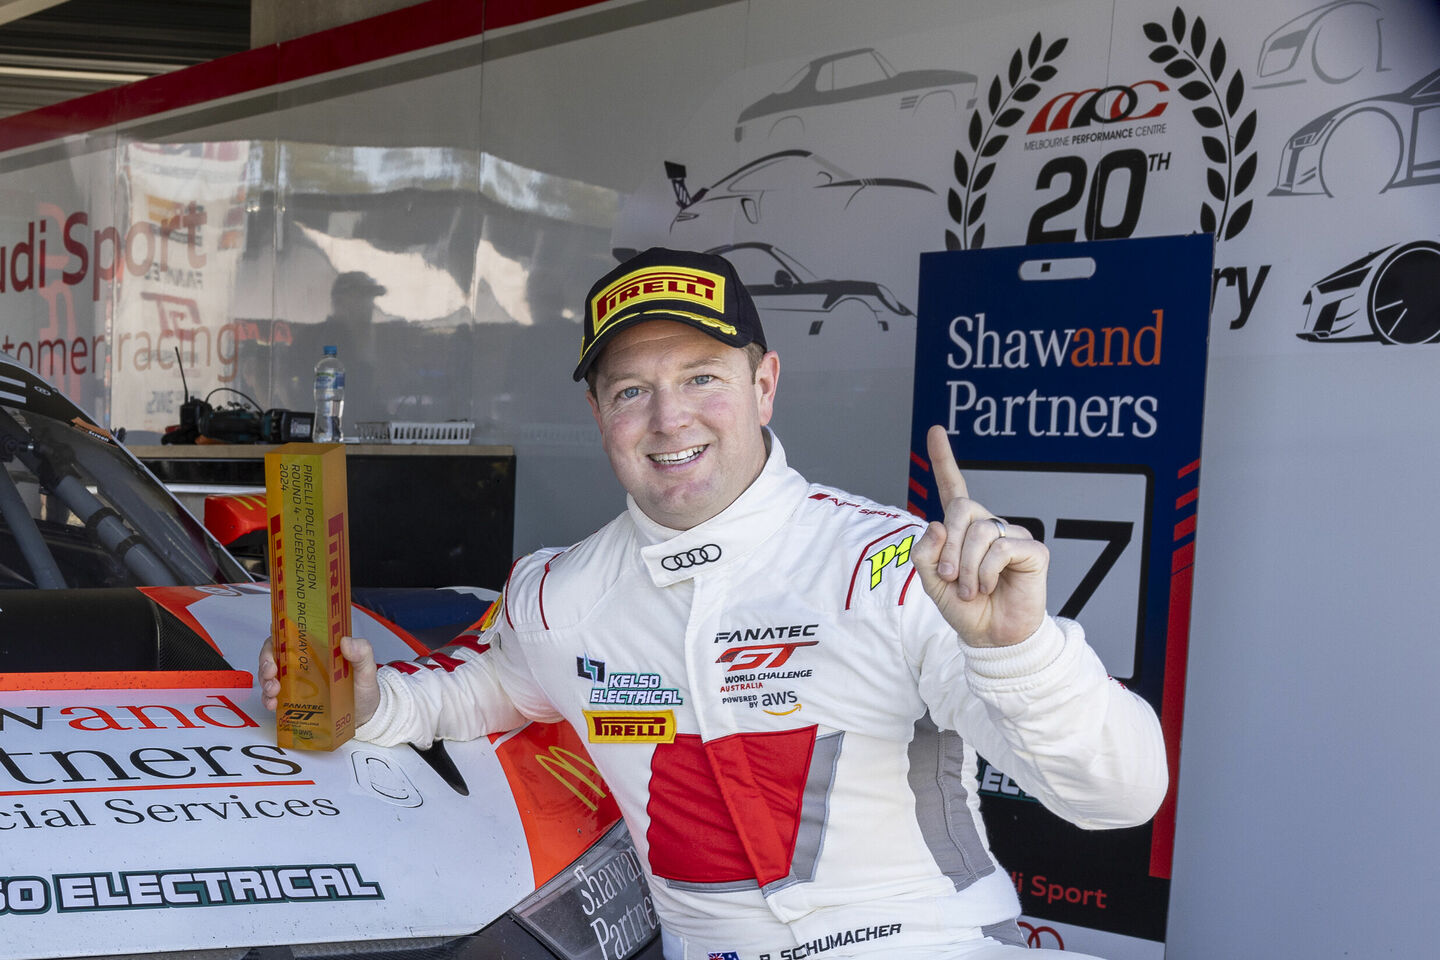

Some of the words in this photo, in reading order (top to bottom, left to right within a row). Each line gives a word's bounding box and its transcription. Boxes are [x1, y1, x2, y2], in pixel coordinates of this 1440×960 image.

[1024, 136, 1069, 151] MELBOURNE
[1072, 128, 1133, 145] PERFORMANCE
[1135, 123, 1167, 138] CENTRE
[62, 201, 208, 302] Sport
[597, 272, 716, 322] PIRELLI
[118, 321, 239, 384] racing
[945, 380, 1159, 438] Partners
[279, 463, 290, 492] 2024
[291, 464, 302, 504] ROUND
[303, 464, 314, 506] PIRELLI
[305, 507, 315, 537] POLE
[293, 523, 306, 600] QUEENSLAND
[306, 538, 317, 590] POSITION
[865, 535, 915, 591] P1
[328, 512, 349, 683] PIRELLI
[297, 601, 308, 655] RACEWAY
[714, 624, 819, 643] FANATEC
[715, 641, 820, 672] GT
[607, 672, 662, 689] KELSO
[720, 682, 764, 693] AUSTRALIA
[725, 673, 756, 684] WORLD
[757, 669, 813, 681] CHALLENGE
[283, 702, 325, 711] FANATEC
[589, 688, 683, 706] ELECTRICAL
[722, 694, 758, 704] POWERED
[761, 691, 798, 707] aws
[284, 709, 324, 720] GT
[335, 713, 352, 731] SRO
[593, 716, 667, 736] PIRELLI
[105, 794, 341, 827] Services
[55, 863, 385, 914] ELECTRICAL
[1030, 875, 1107, 909] Sport
